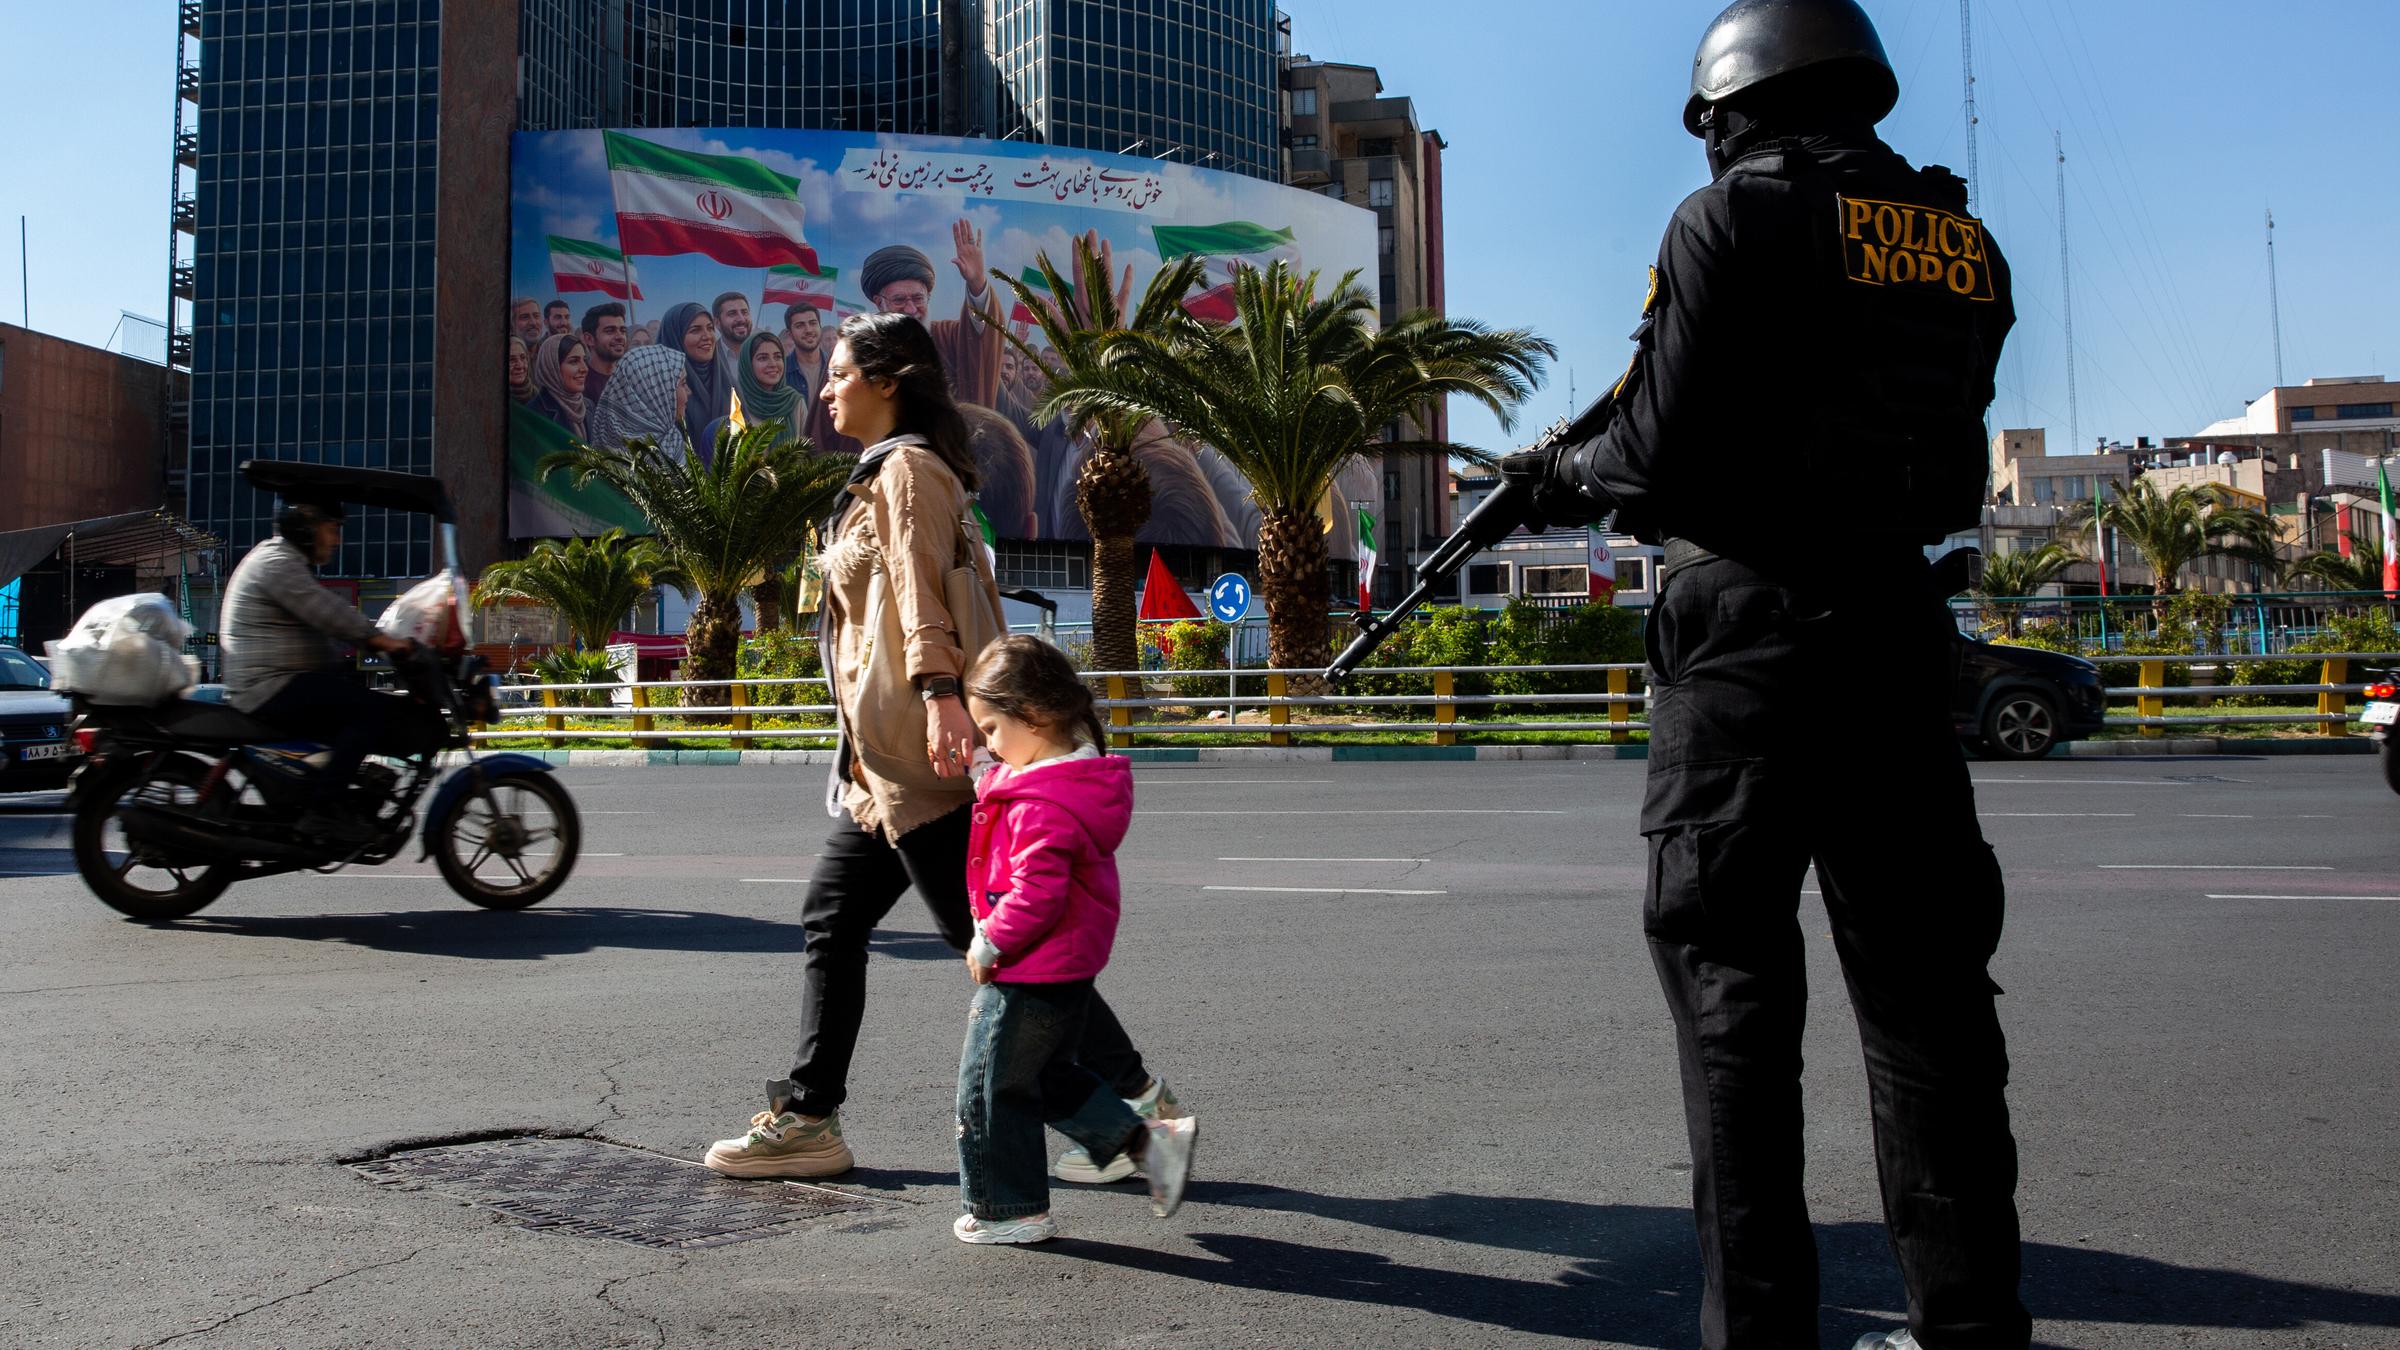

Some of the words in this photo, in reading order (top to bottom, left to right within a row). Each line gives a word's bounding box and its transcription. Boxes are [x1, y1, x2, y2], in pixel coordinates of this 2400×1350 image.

[898, 161, 931, 189] زمین
[931, 169, 944, 188] بر
[946, 163, 994, 195] پرچمت
[1014, 161, 1060, 189] بهشت
[1133, 177, 1162, 209] خوش
[1846, 200, 1982, 262] POLICE
